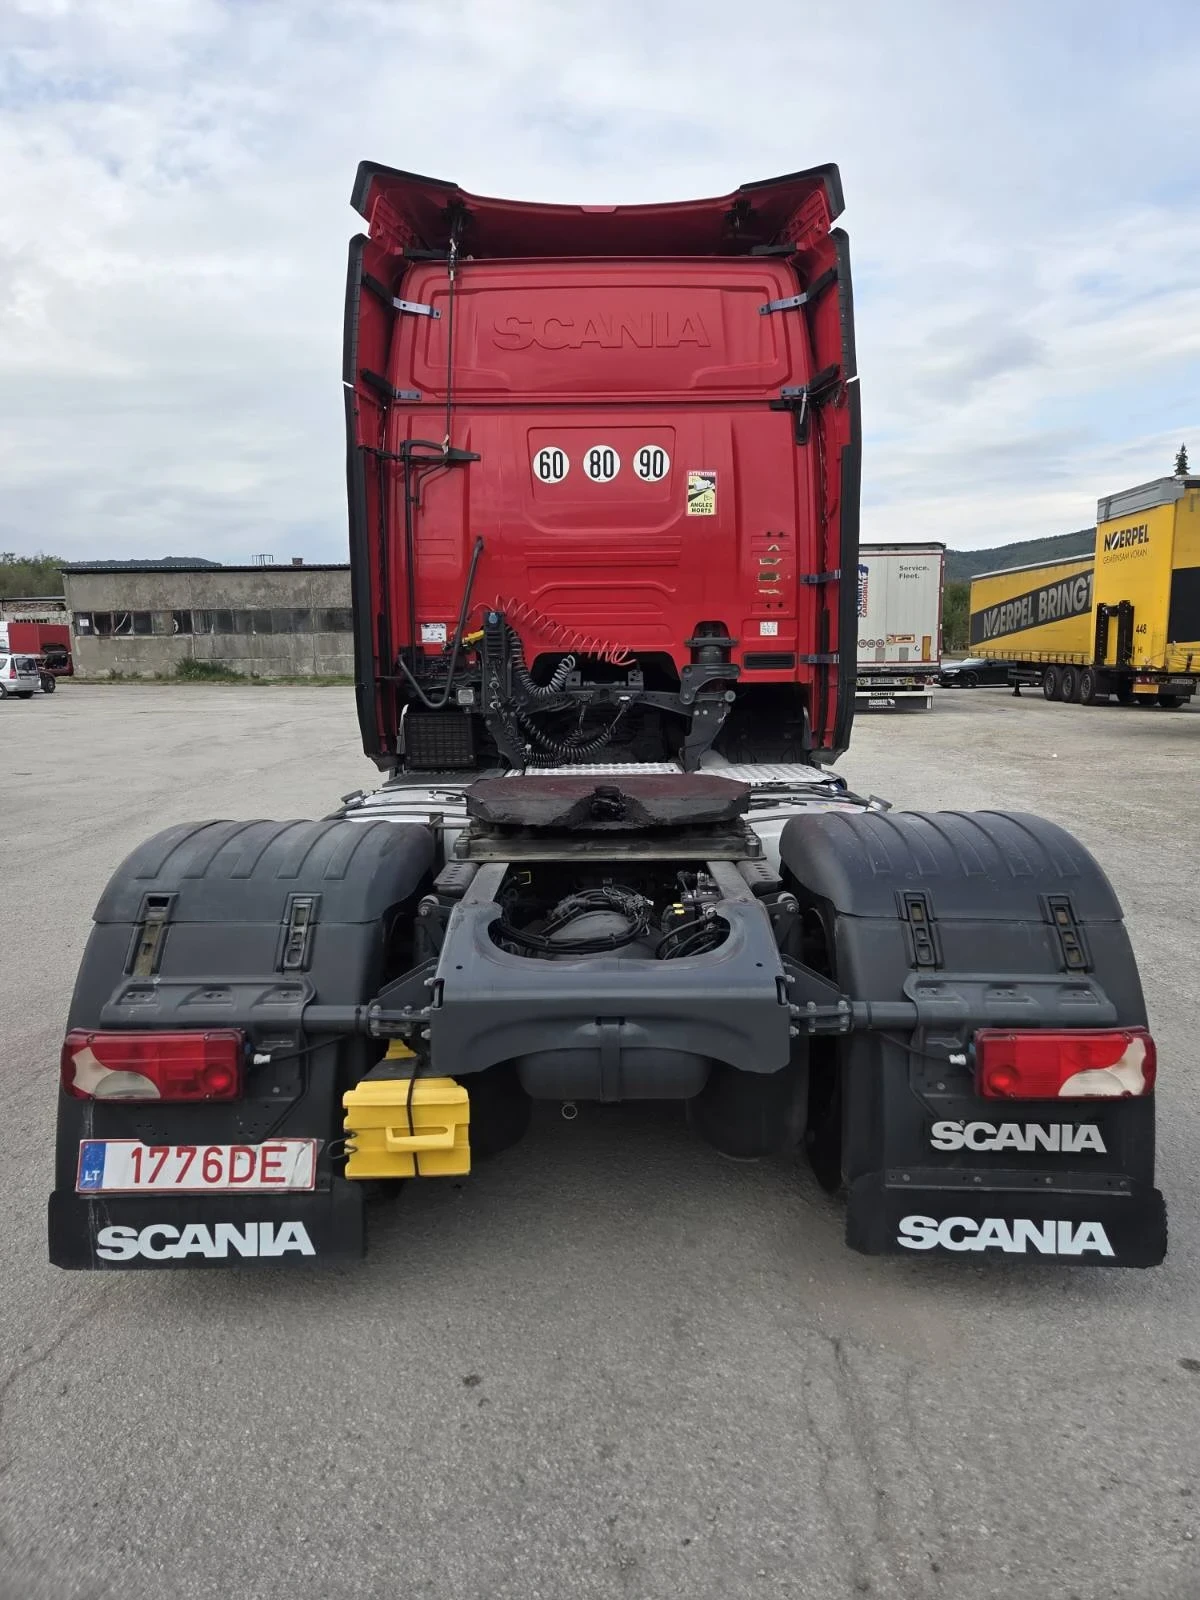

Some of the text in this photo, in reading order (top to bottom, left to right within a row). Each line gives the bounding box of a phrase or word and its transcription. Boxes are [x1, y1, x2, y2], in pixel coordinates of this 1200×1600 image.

[492, 311, 711, 350] SCANIA
[539, 450, 564, 479] 60
[589, 449, 614, 478] 80
[639, 449, 664, 478] 90
[1104, 524, 1149, 552] NOERPEL
[930, 1120, 1107, 1153] SCANIA
[85, 1146, 287, 1184] LT 1776DE
[96, 1221, 317, 1261] SCANIA
[896, 1215, 1116, 1257] SCANIA
